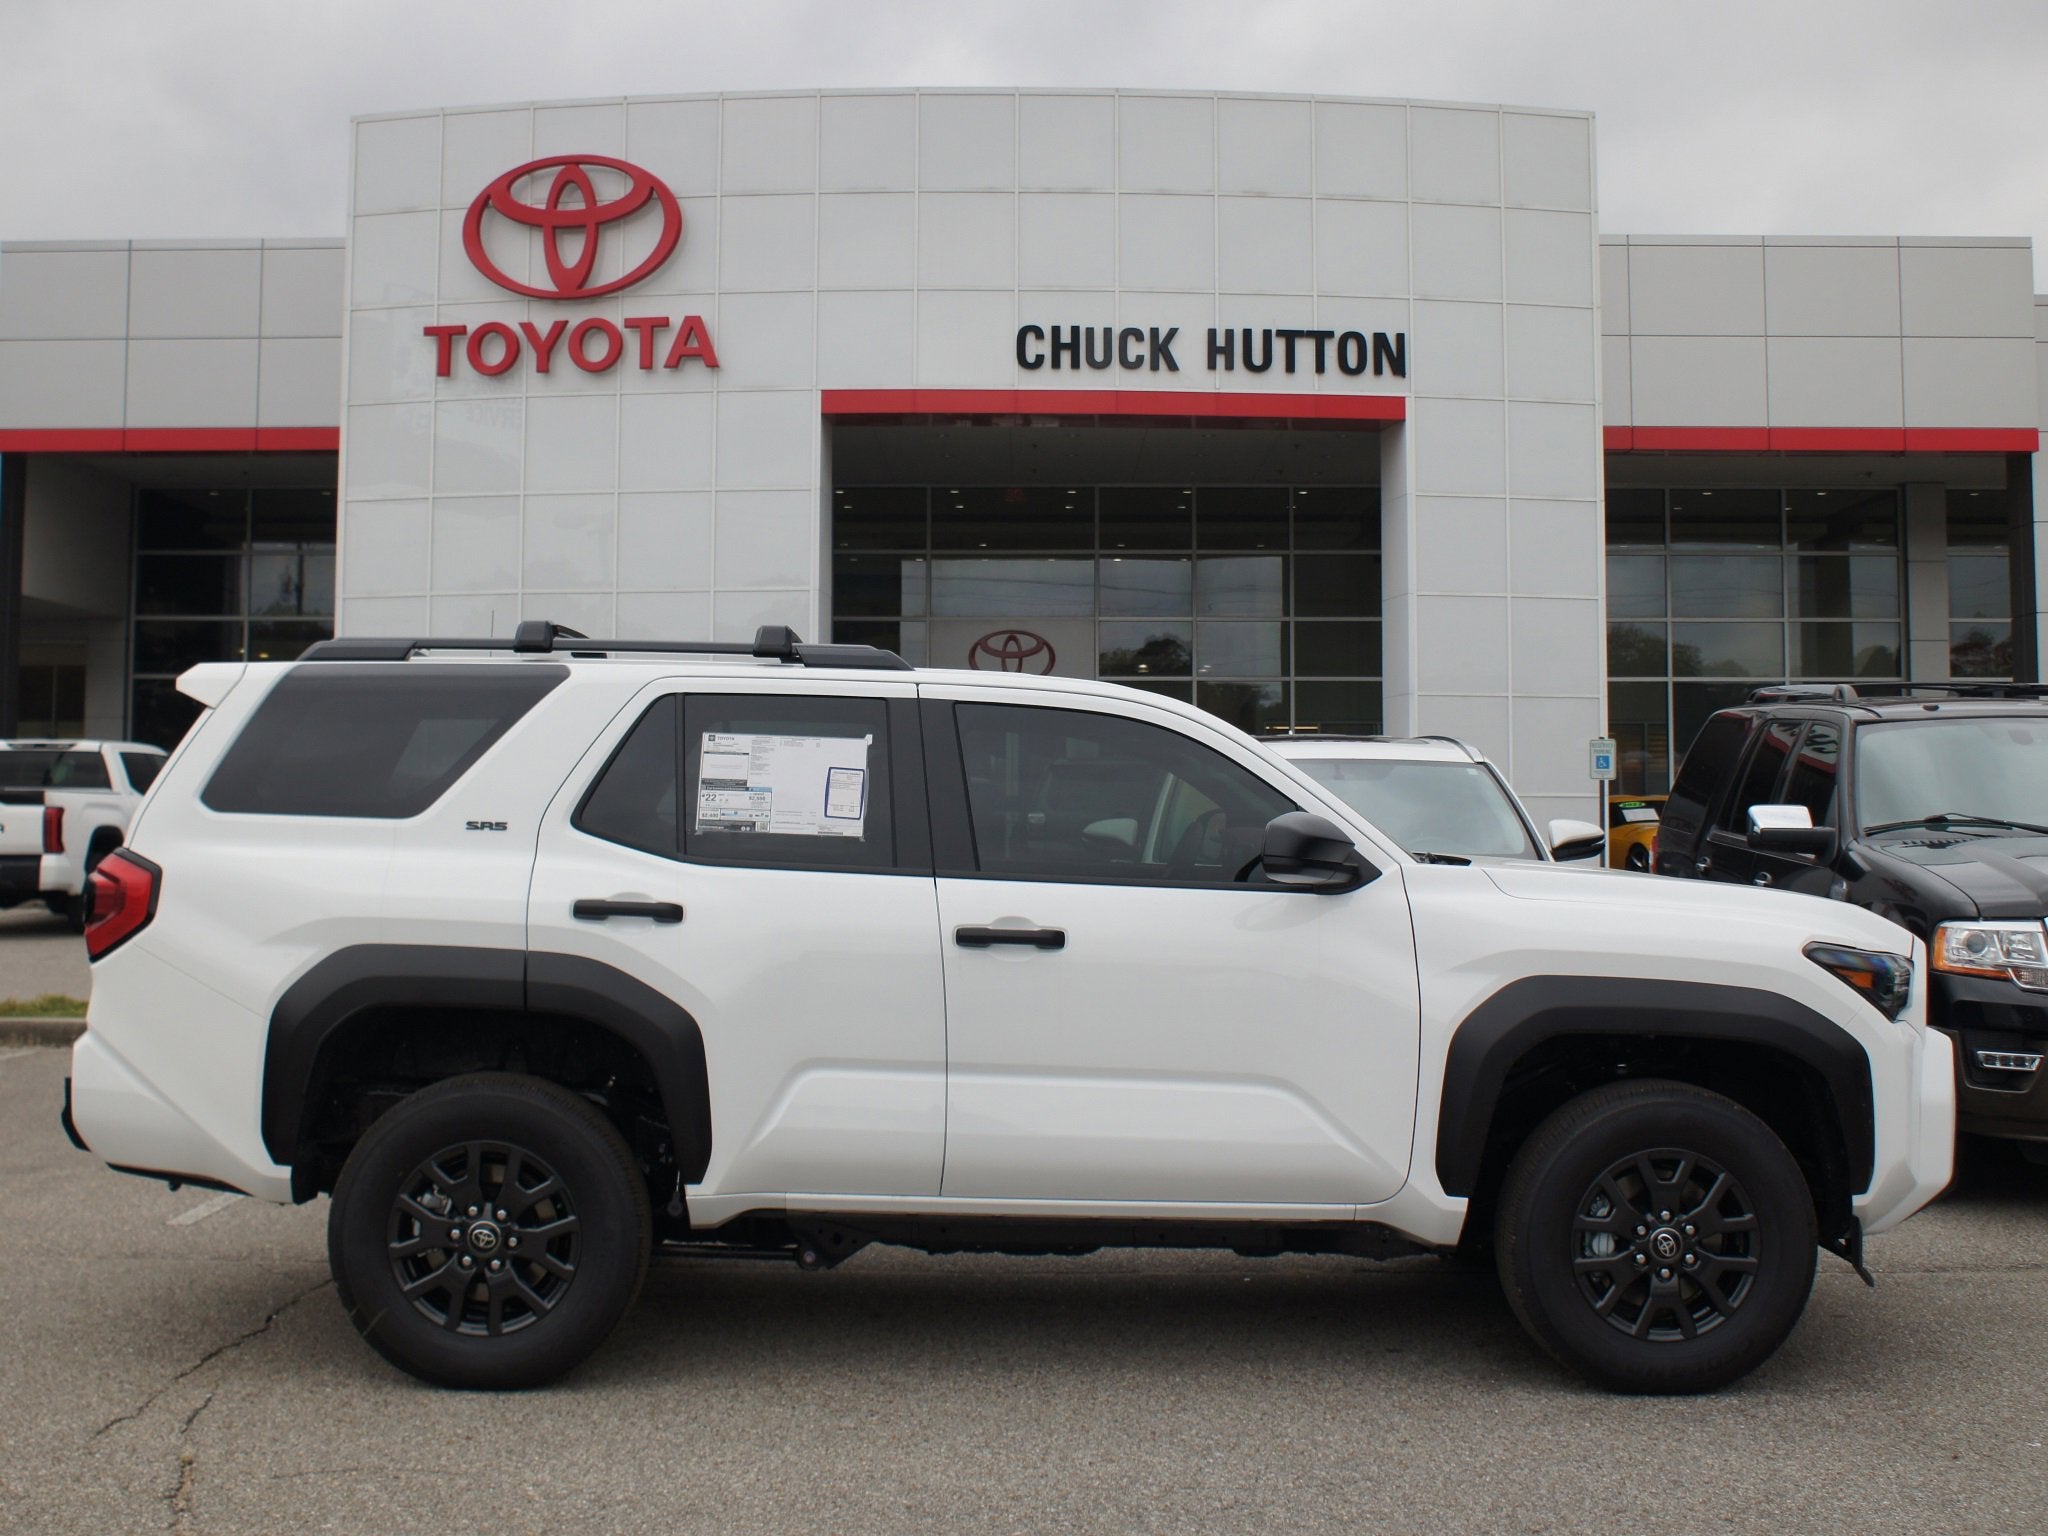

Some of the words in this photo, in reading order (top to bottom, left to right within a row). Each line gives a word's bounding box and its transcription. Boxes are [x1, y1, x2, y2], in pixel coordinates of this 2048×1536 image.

[423, 315, 720, 377] TOYOTA
[1016, 324, 1180, 372] CHUCK
[1207, 327, 1407, 378] HUTTON
[705, 793, 717, 802] 22
[465, 821, 508, 831] SR5
